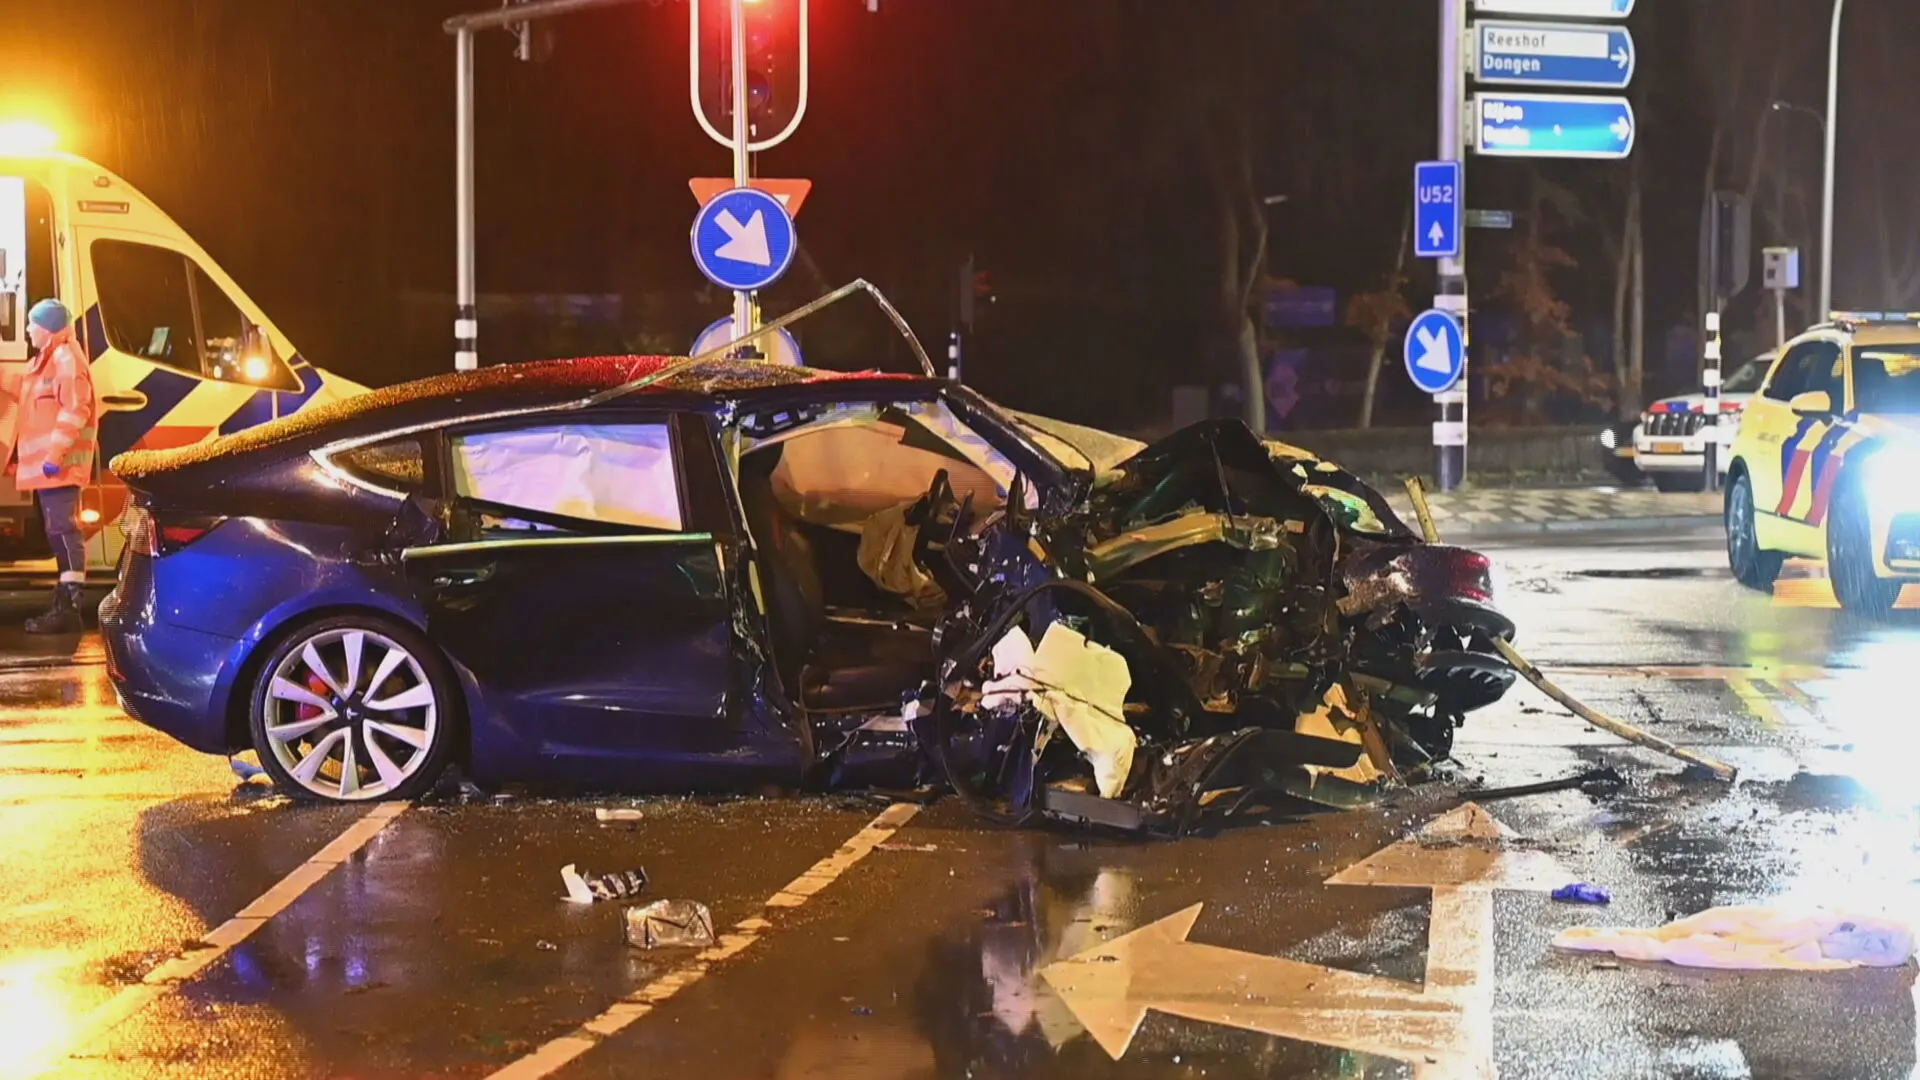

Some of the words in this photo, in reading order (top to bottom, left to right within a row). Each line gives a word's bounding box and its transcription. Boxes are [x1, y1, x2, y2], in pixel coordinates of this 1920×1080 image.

[1487, 32, 1546, 48] Reeshof
[1483, 54, 1541, 75] Dongen
[1420, 185, 1453, 204] U52
